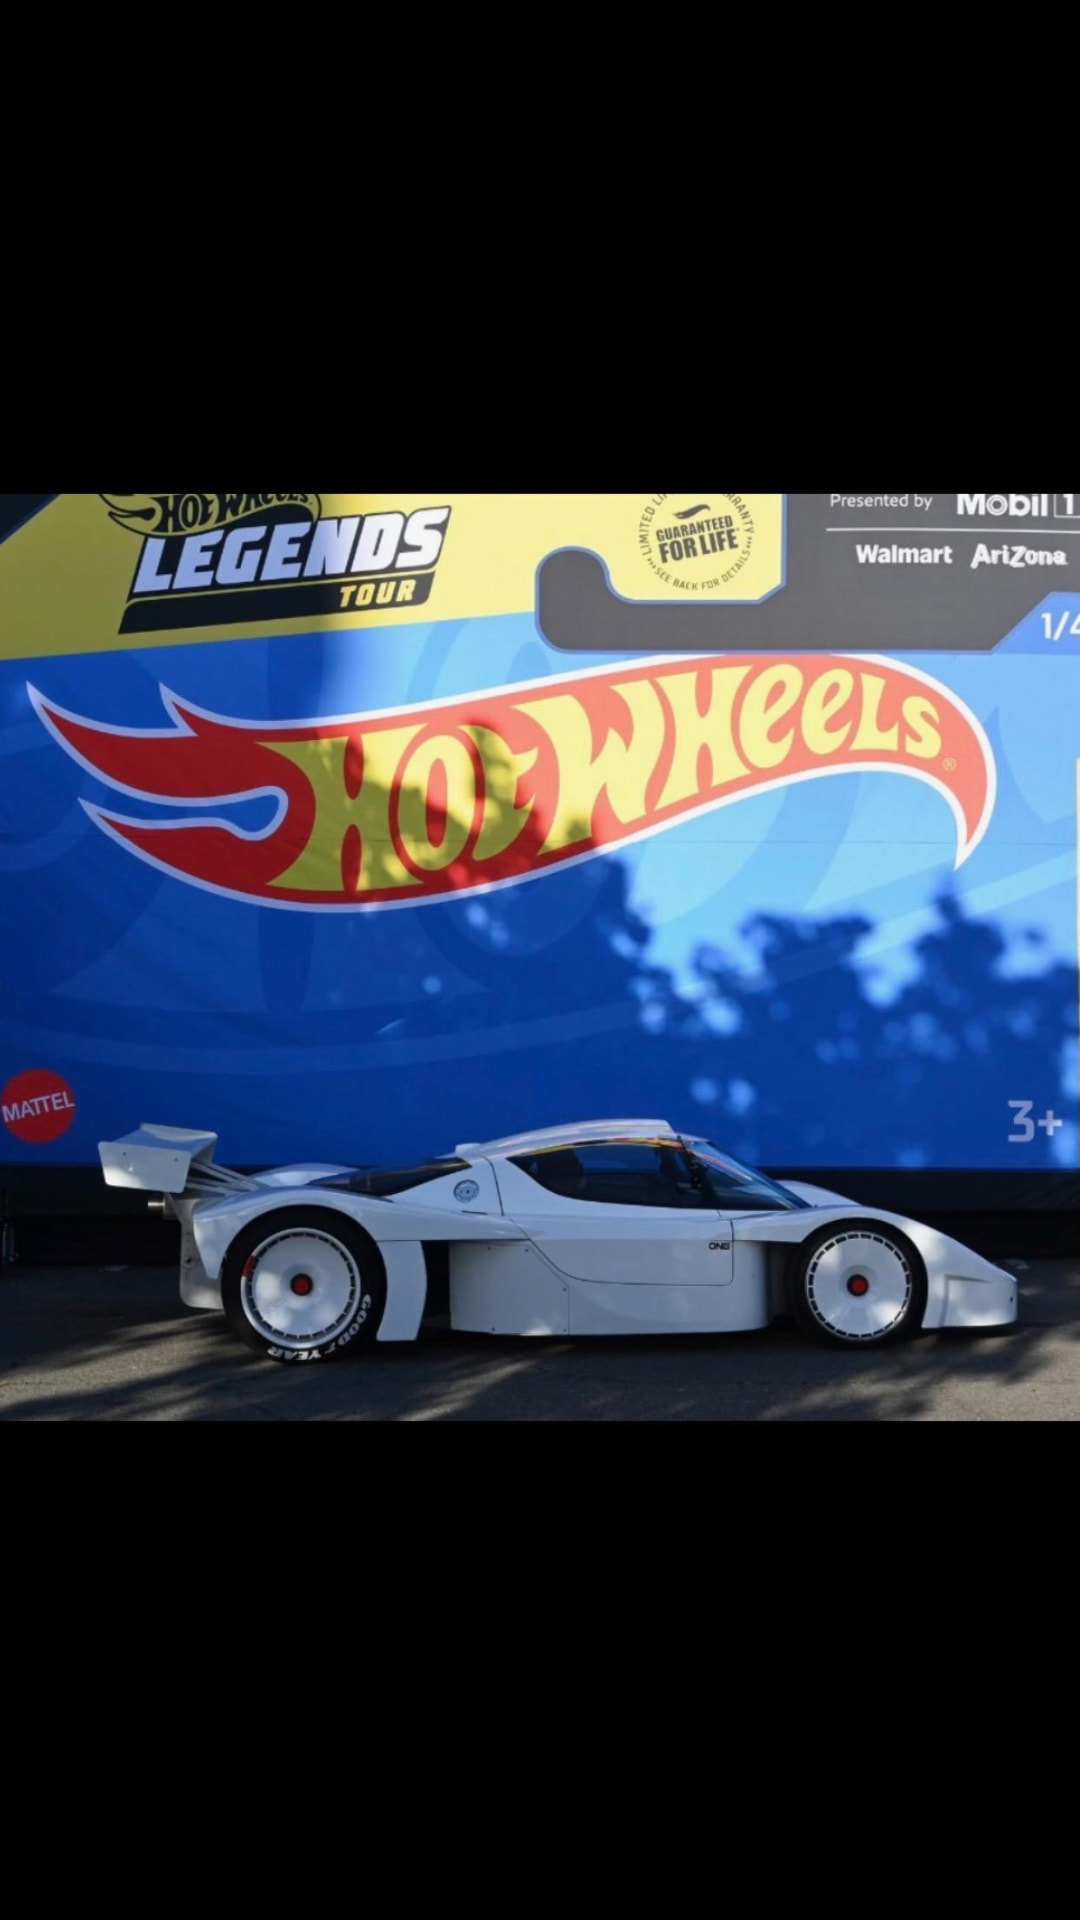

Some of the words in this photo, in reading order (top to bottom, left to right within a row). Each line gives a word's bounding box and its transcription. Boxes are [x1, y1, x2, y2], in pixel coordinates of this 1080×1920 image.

[829, 494, 909, 508] Presented
[914, 494, 933, 511] by
[957, 494, 1048, 516] Mobil
[656, 515, 734, 542] GUARANTEED
[132, 506, 452, 593] LEGENDS
[659, 537, 698, 563] FOR
[699, 528, 739, 555] LIFE
[856, 545, 953, 564] Walmart
[654, 567, 672, 583] SEE
[672, 578, 698, 590] BACK
[701, 578, 720, 590] FOR
[721, 550, 751, 582] DETAILS
[340, 579, 416, 607] TOUR
[253, 721, 540, 892] HOT
[1, 1091, 76, 1122] MATTEL
[1008, 1100, 1062, 1142] 3+
